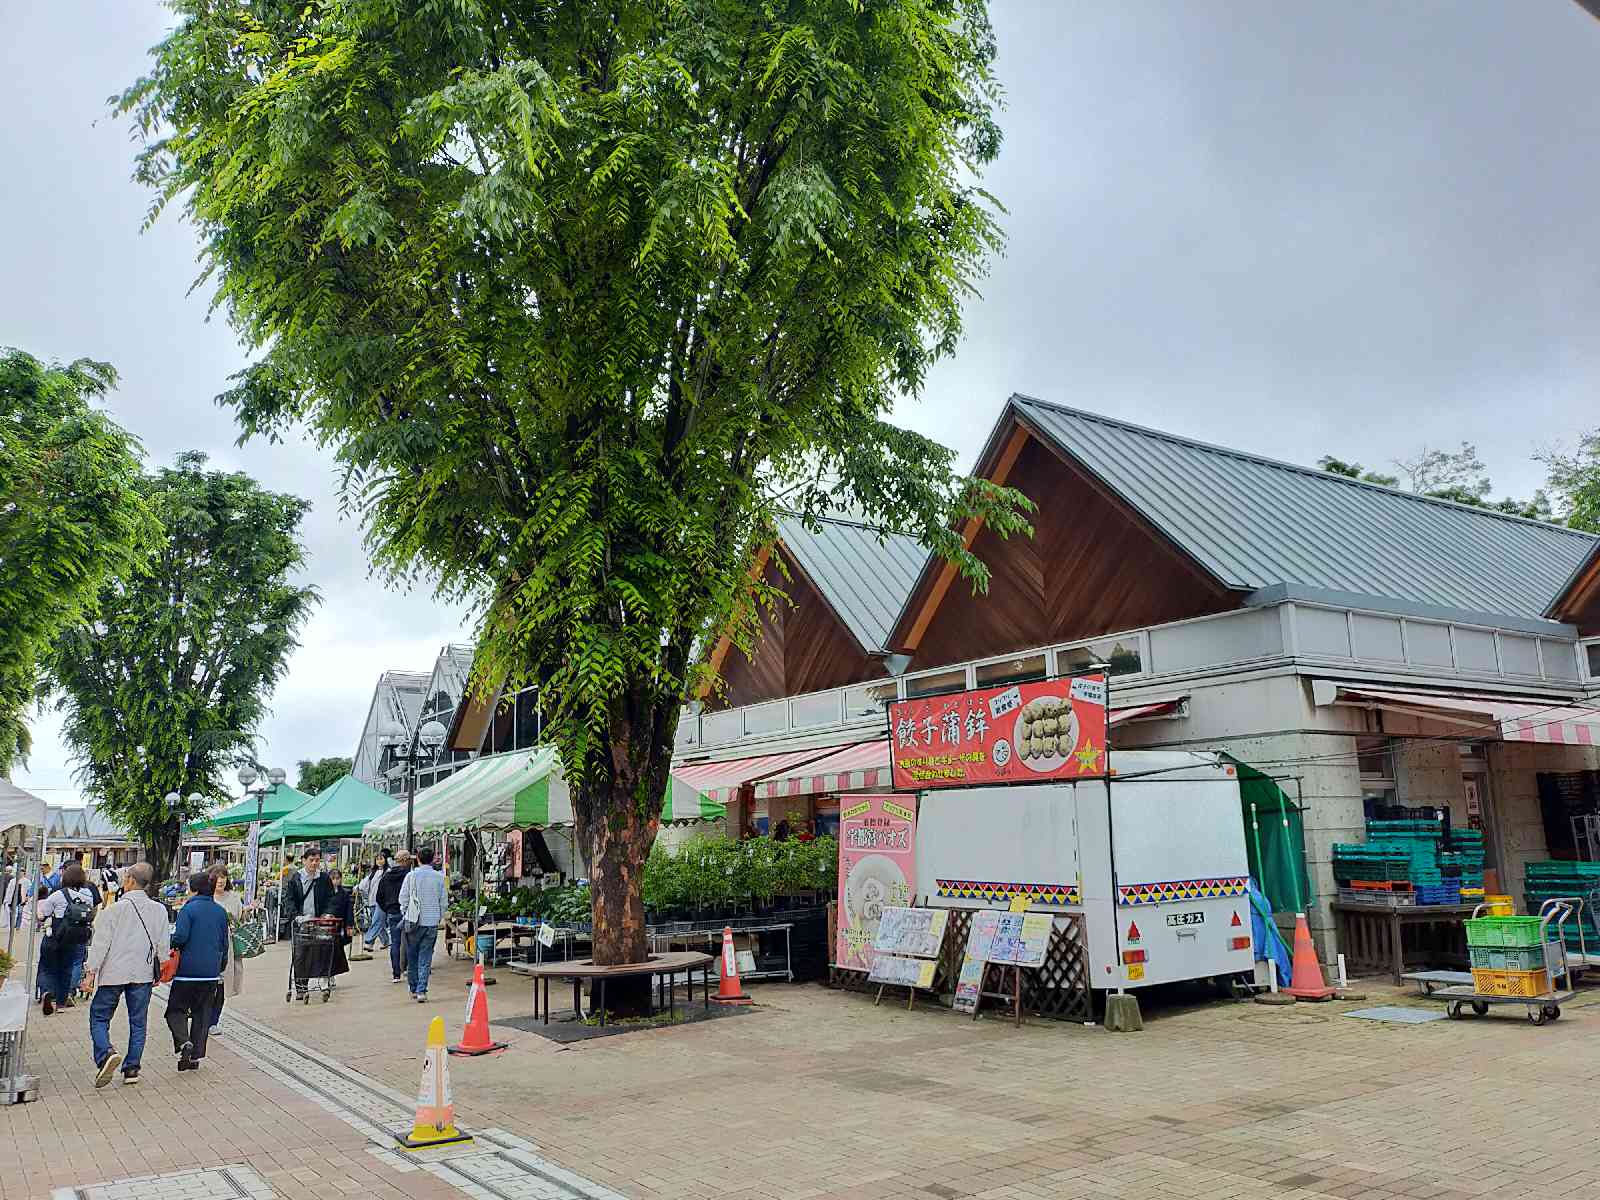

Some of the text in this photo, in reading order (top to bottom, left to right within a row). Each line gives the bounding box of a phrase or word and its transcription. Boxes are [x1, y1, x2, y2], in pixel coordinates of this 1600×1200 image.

[896, 709, 990, 750] 餃子蒲鉾
[1167, 913, 1204, 925] 高圧ガス
